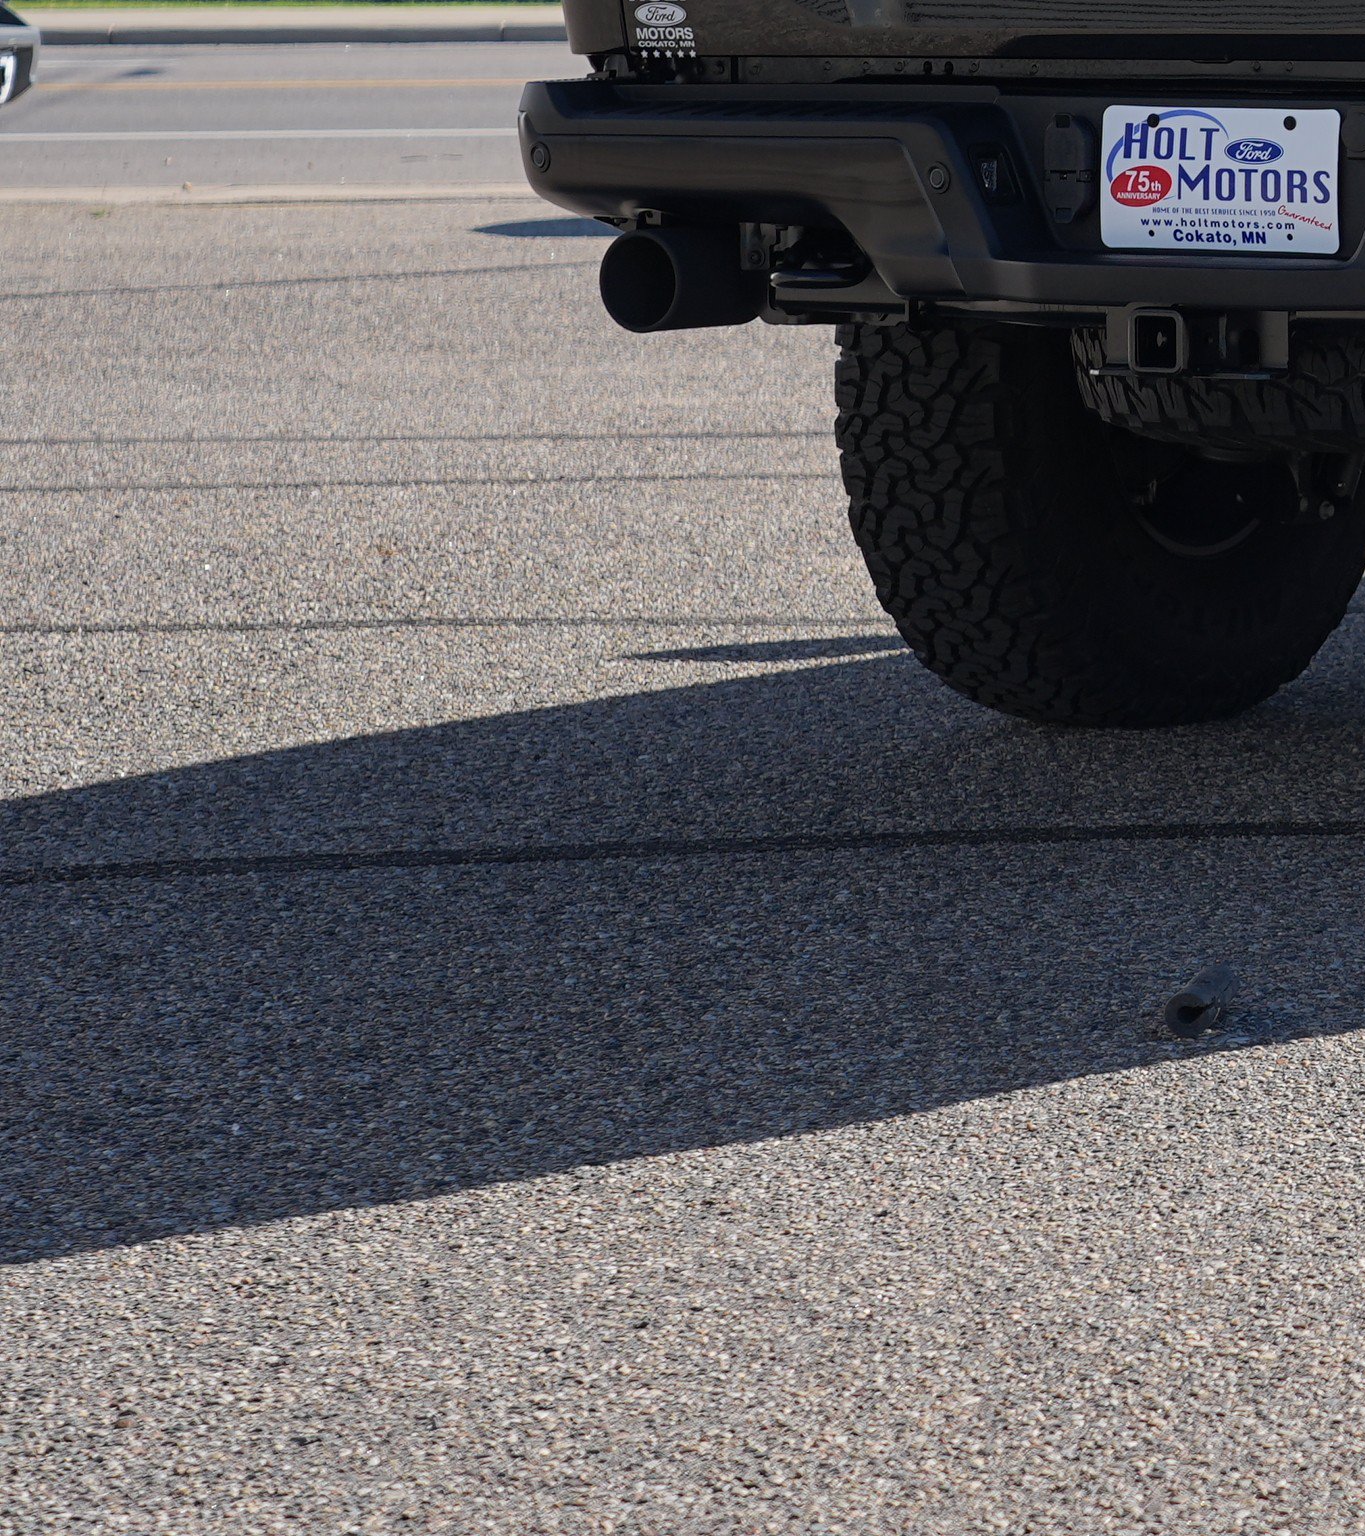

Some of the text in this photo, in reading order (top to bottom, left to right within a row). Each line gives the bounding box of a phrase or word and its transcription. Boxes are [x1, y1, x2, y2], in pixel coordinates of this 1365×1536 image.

[645, 5, 676, 22] Ford
[636, 27, 694, 40] MOTORS
[638, 40, 678, 48] COKATO,
[1123, 122, 1220, 161] HOLT
[1235, 140, 1272, 162] Ford
[1125, 170, 1162, 192] 75th
[1177, 164, 1330, 204] MOTORS
[1116, 191, 1161, 200] ANNIVERSARY
[1152, 206, 1170, 214] HOME
[1182, 207, 1193, 215] THE
[1277, 205, 1332, 231] Guaranteed
[1140, 217, 1295, 230] www.holtmotors.com
[1173, 229, 1267, 246] Cokato, MN
